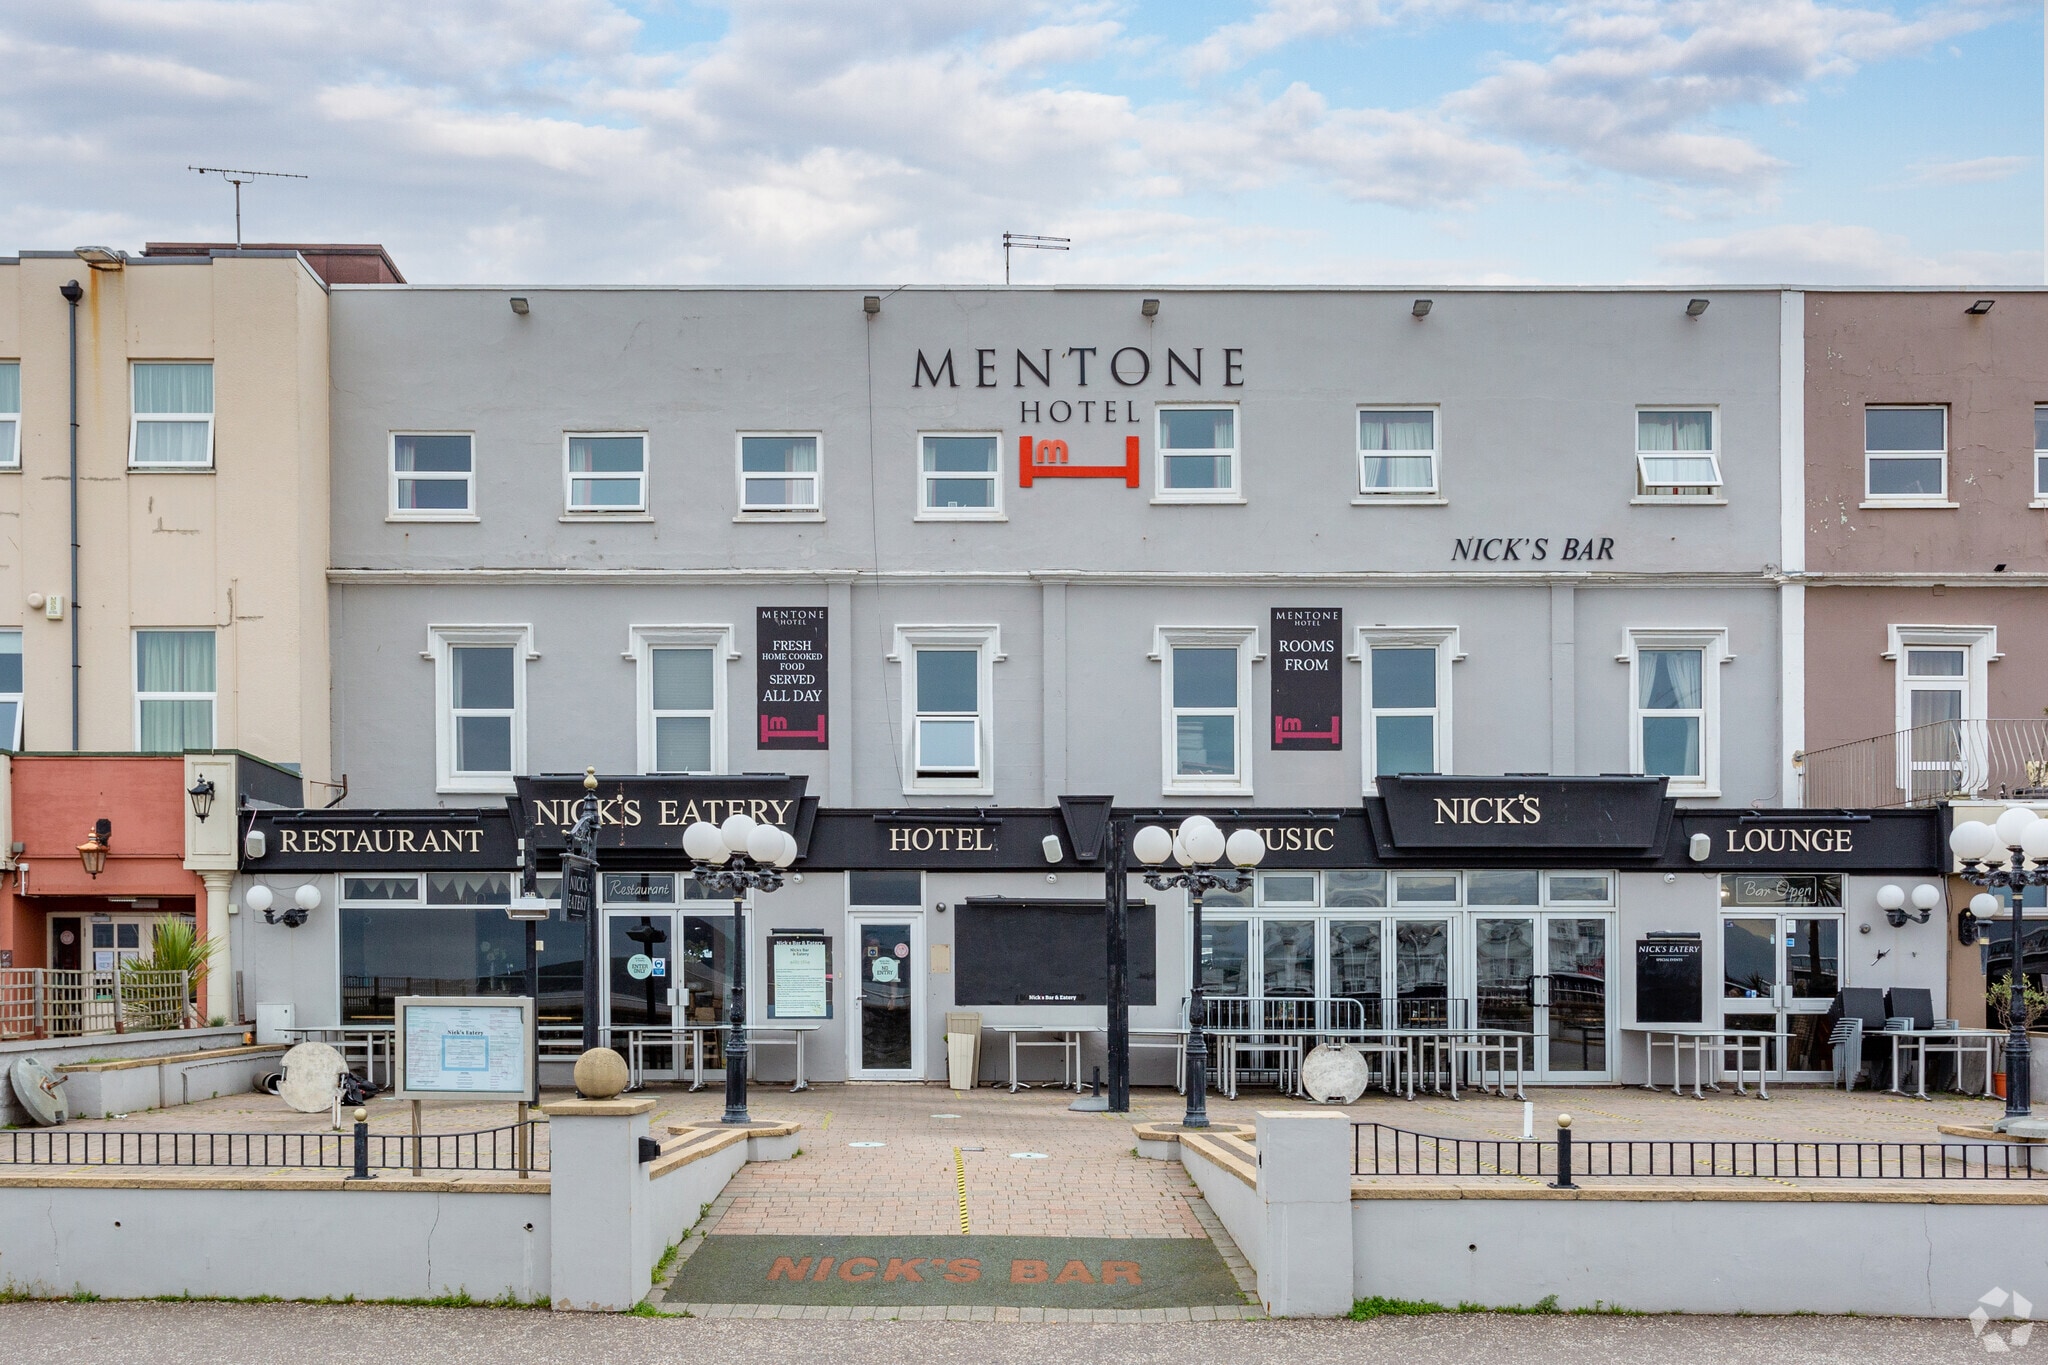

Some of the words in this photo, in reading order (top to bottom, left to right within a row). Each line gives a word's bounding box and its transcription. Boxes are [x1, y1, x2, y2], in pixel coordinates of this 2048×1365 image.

[911, 347, 1245, 388] MENTONE
[1020, 400, 1141, 423] HOTEL
[1450, 537, 1549, 562] NICK'S
[1560, 537, 1615, 561] BAR
[762, 610, 824, 619] MENTONE
[1276, 611, 1339, 620] MENTONE
[772, 640, 812, 651] FRESH
[1278, 640, 1335, 653] ROOMS
[762, 652, 787, 661] HOME
[788, 652, 823, 661] COOKED
[1284, 658, 1329, 671] FROM
[779, 662, 806, 671] FOOD
[769, 674, 816, 685] SERVED
[762, 689, 791, 702] ALL
[793, 690, 823, 702] DAY
[657, 799, 794, 826] EATERY
[1432, 793, 1541, 824] NICK'S
[279, 829, 484, 853] RESTAURANT
[888, 827, 993, 851] HOTEL
[1236, 827, 1335, 852] USIC
[1726, 828, 1853, 852] LOUNGE
[569, 875, 589, 893] NICK'S
[609, 879, 670, 897] Restaurant
[1743, 880, 1771, 896] Bar
[1775, 879, 1812, 902] Open
[567, 893, 588, 911] EATERY
[1638, 945, 1667, 953] NICK'S
[1669, 945, 1700, 953] EATERY
[766, 1256, 983, 1283] NICK'S
[1010, 1259, 1143, 1286] BAR
